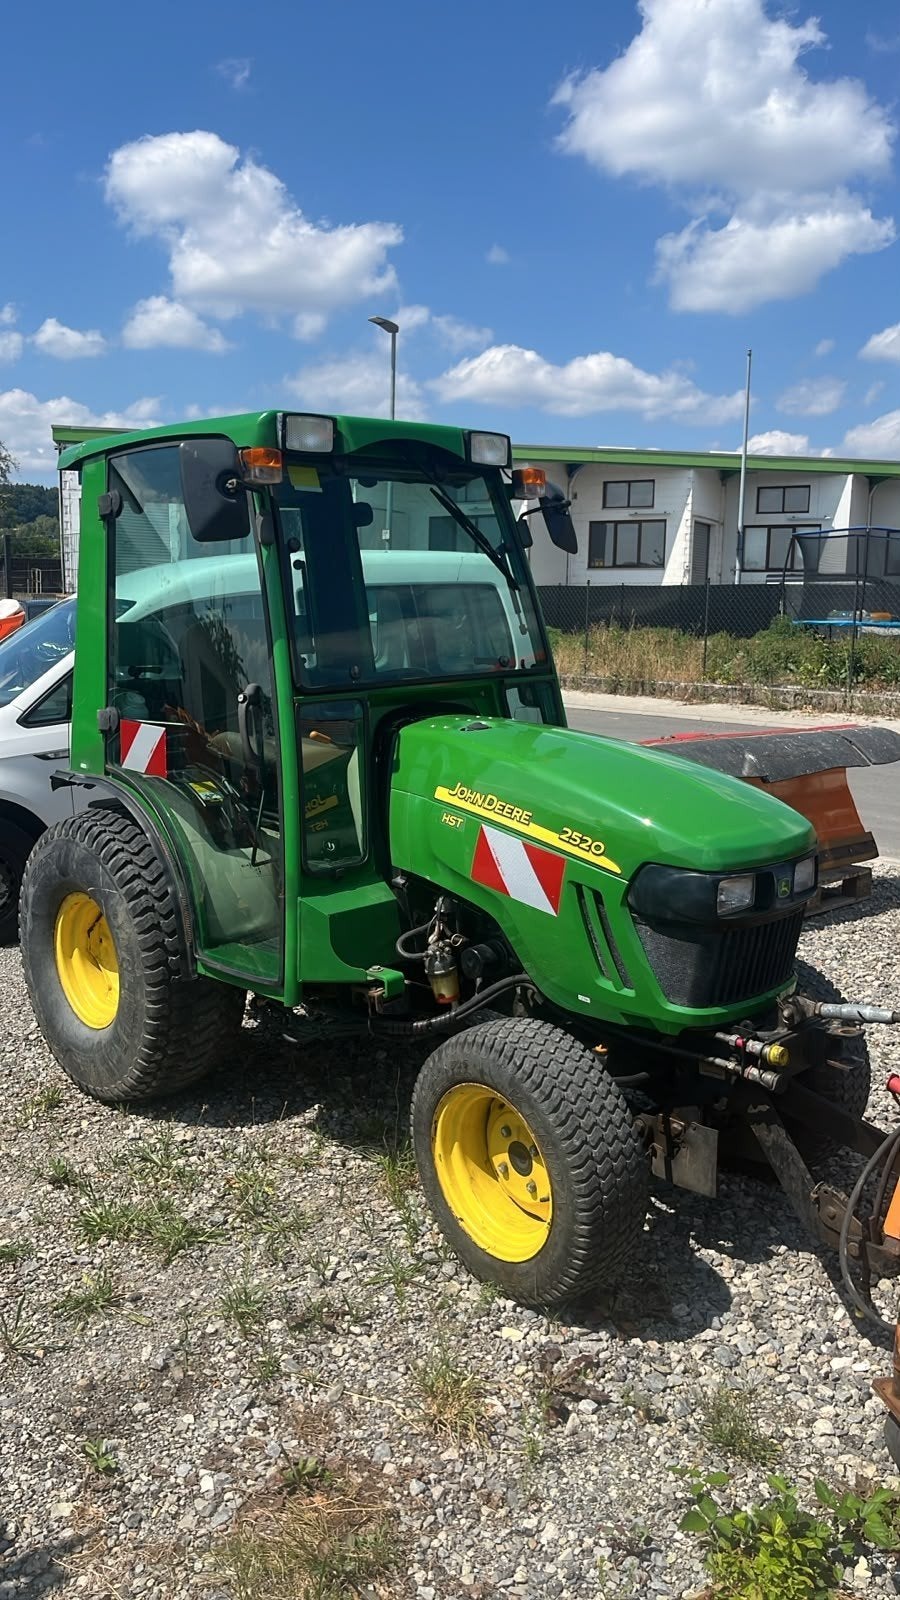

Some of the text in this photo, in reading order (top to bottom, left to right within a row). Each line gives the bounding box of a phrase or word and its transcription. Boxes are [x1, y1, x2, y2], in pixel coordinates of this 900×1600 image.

[448, 782, 533, 825] JOHN DEERE
[441, 813, 464, 828] HST
[558, 827, 605, 855] 2520
